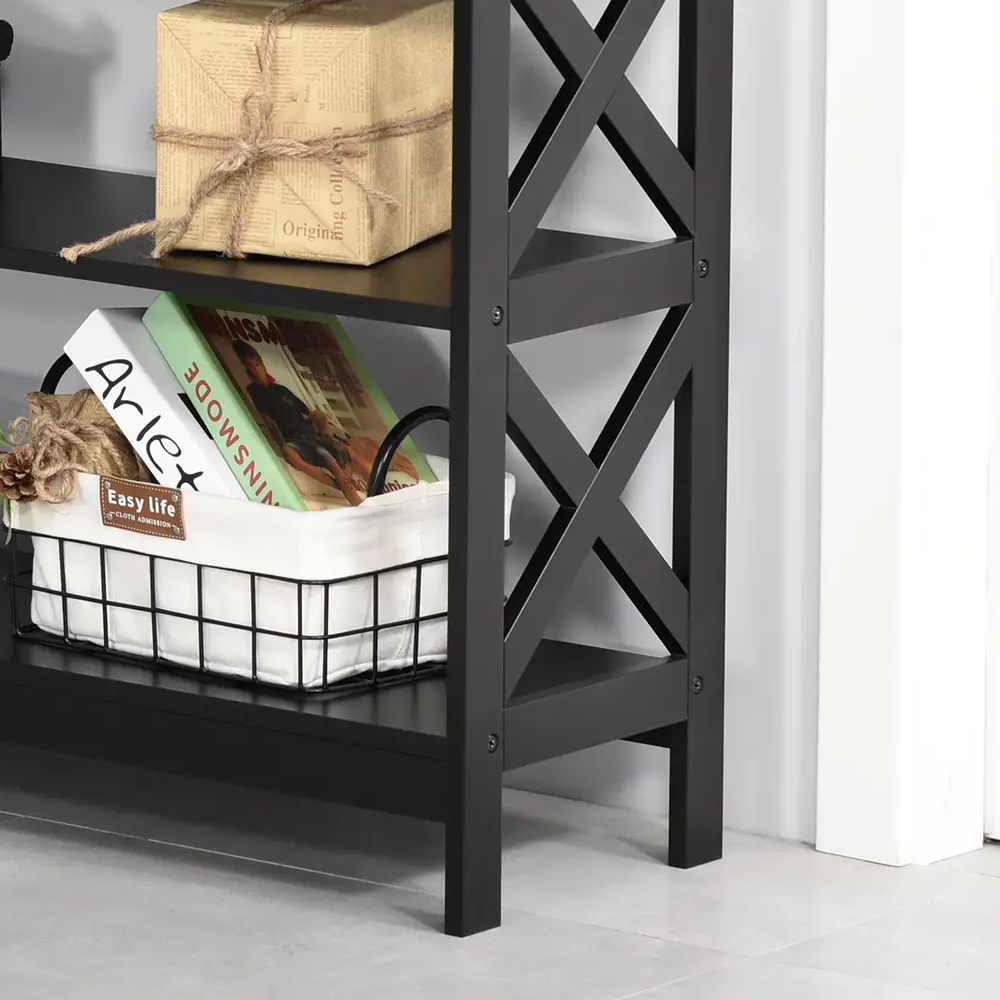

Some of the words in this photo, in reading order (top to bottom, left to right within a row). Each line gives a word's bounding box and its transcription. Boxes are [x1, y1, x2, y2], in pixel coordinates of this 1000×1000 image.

[107, 489, 144, 513] Easy
[149, 496, 176, 517] life
[115, 511, 136, 521] CLOTH
[137, 516, 171, 529] ADMISSION
